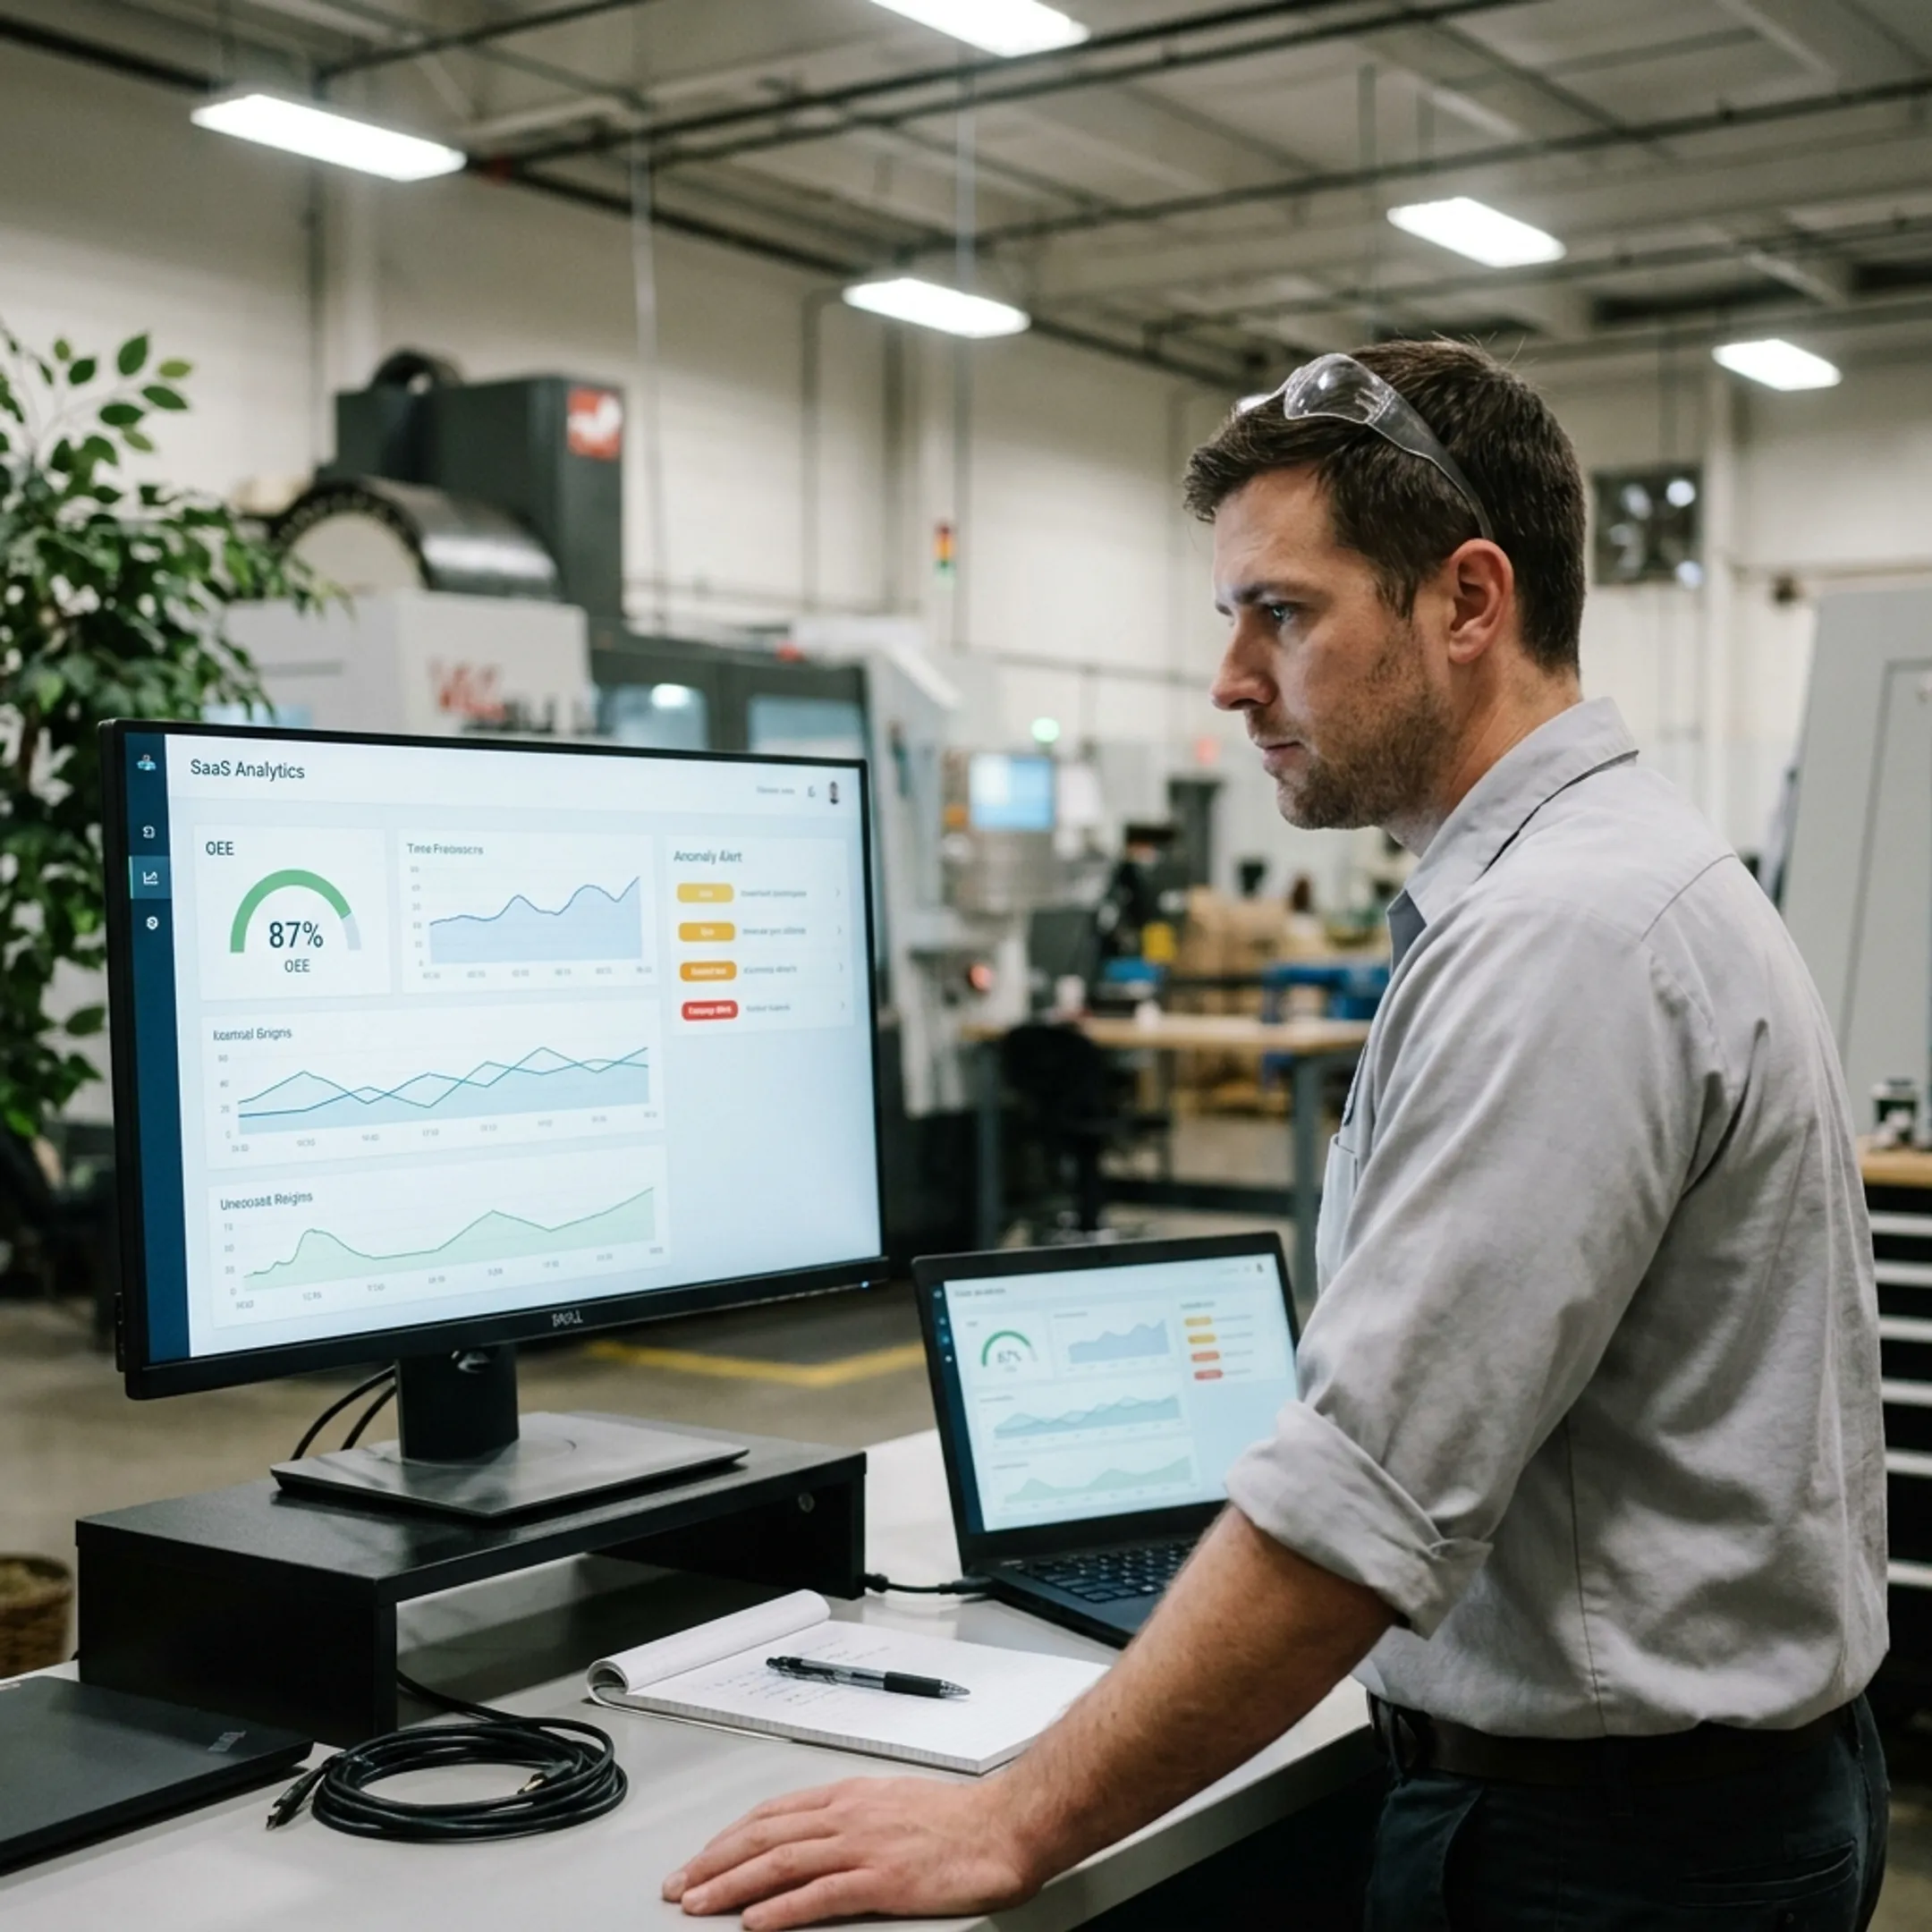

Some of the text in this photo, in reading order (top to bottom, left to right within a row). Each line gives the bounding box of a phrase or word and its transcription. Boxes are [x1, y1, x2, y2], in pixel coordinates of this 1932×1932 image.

[190, 758, 305, 783] SaaS Analytics
[205, 841, 234, 856] OEE
[268, 920, 324, 949] 87%
[284, 959, 310, 973] OEE
